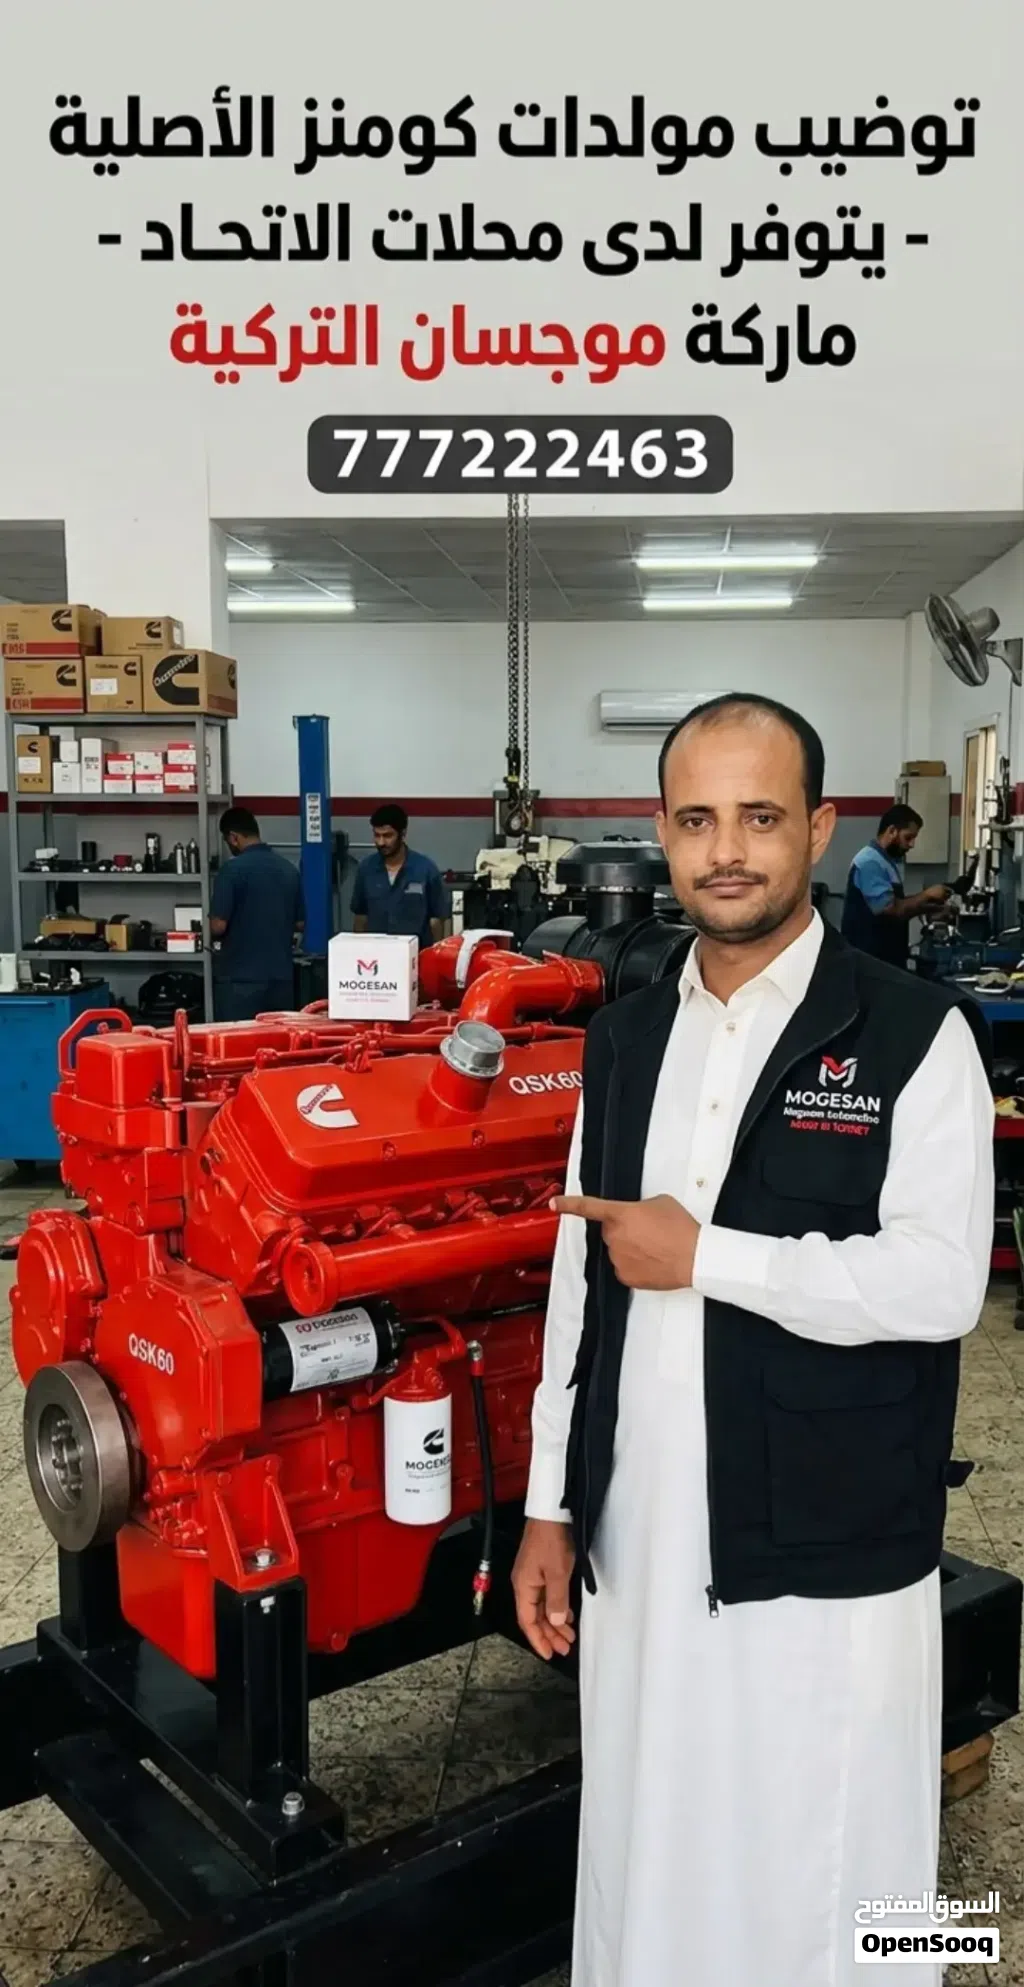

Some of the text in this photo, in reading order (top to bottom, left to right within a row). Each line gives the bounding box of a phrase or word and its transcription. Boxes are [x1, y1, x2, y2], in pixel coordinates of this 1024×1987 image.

[508, 1070, 583, 1095] QSK60
[785, 1089, 881, 1112] MOGESAN
[129, 1332, 174, 1375] QSK60
